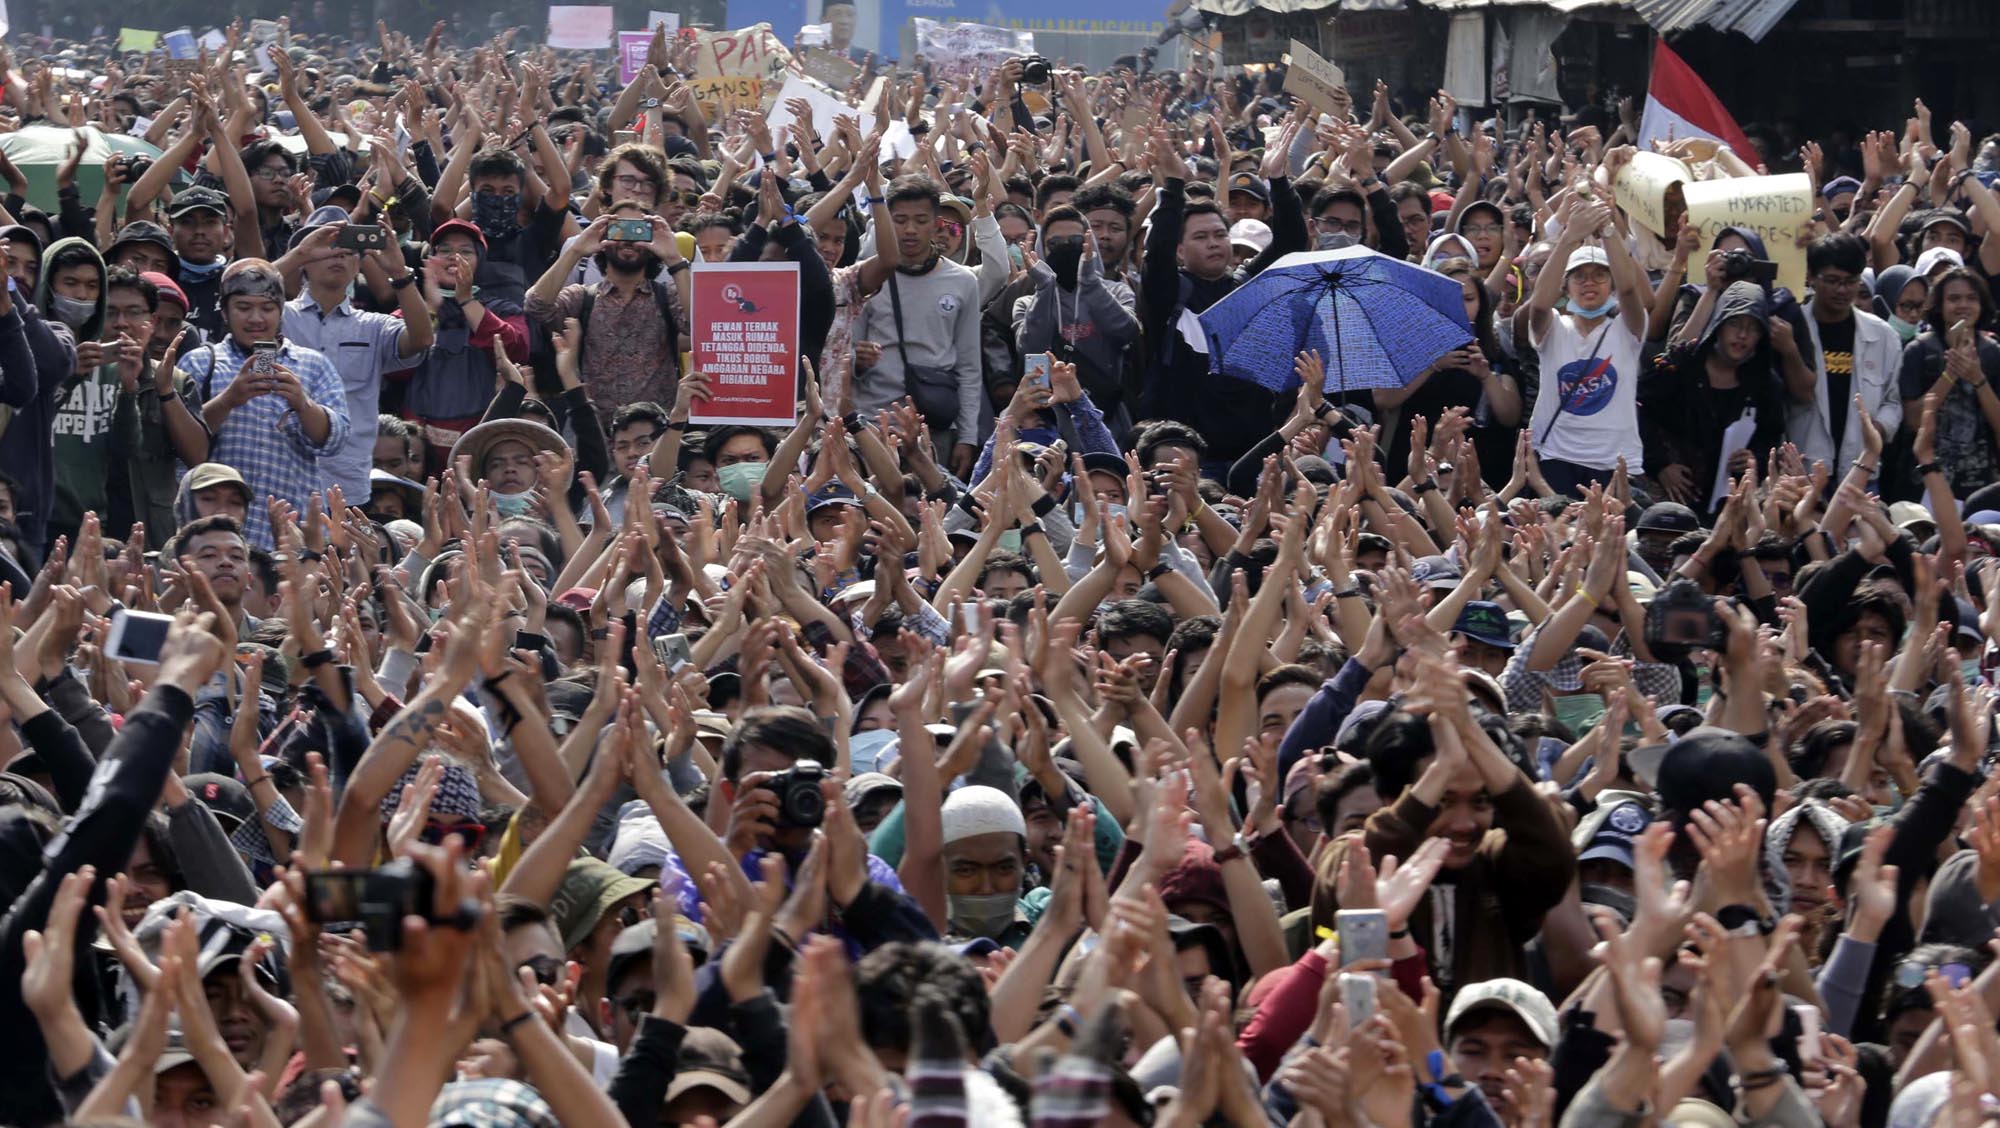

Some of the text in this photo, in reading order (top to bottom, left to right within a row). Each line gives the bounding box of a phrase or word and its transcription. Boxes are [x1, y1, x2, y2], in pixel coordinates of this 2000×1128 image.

[1728, 194, 1807, 213] HYDRATED
[711, 322, 779, 332] HEWAN TERNAK
[712, 332, 776, 342] MASUK RUMAH
[701, 342, 788, 354] TETANGGA DIDENDA,
[716, 353, 772, 364] TIKUS BOBOL
[701, 363, 785, 375] ANGGARAN NEGARA
[719, 374, 768, 385] DIBIARKAN
[1560, 373, 1612, 396] NASA
